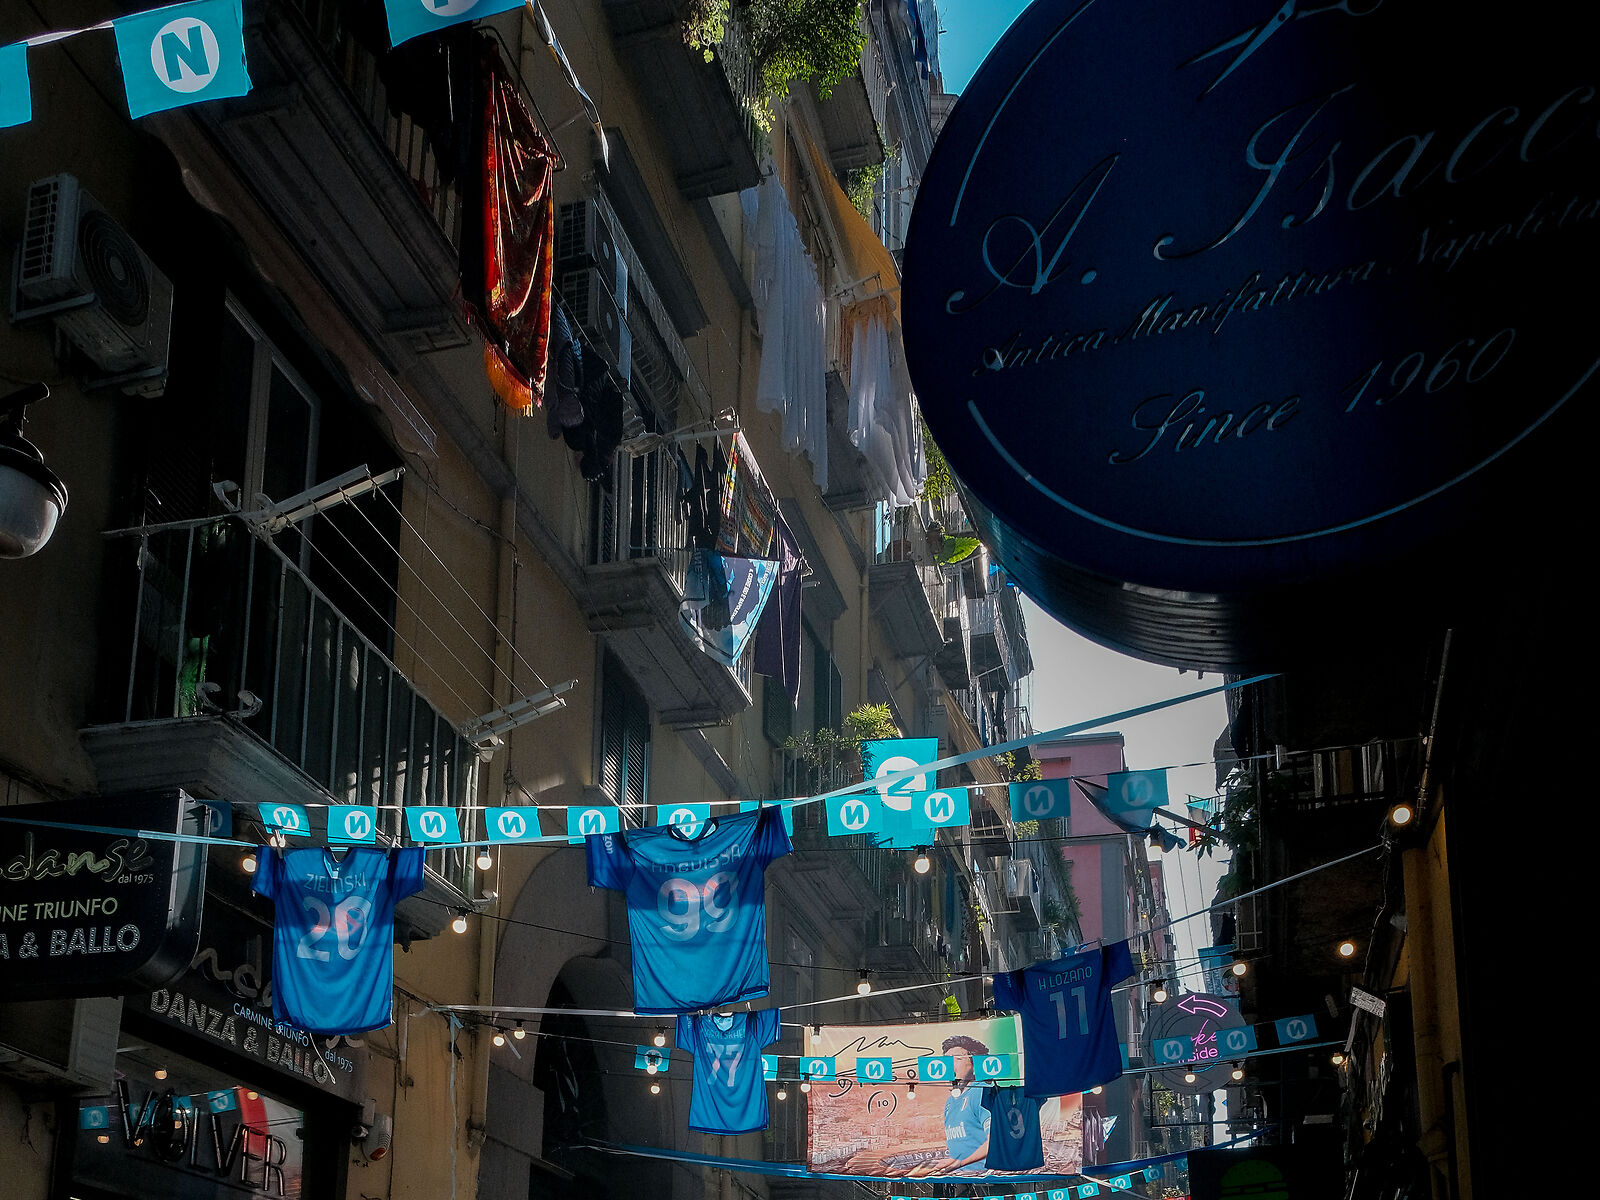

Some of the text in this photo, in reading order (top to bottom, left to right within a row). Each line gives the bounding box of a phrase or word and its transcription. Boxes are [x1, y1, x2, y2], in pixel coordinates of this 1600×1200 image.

[160, 25, 210, 81] N
[946, 82, 1600, 315] A. Isacc
[971, 327, 1106, 378] Antica
[1113, 262, 1378, 347] Manifattura
[1108, 327, 1518, 465] Since 1960
[118, 874, 154, 885] dal 1975
[657, 870, 740, 942] 99
[34, 896, 119, 921] TRIUNFO
[297, 895, 372, 962] 20
[18, 931, 40, 959] &
[49, 923, 141, 957] BALLO
[149, 988, 328, 1084] DANZA & BALLO
[233, 1002, 273, 1031] CARMINE
[1049, 986, 1089, 1040] 11
[324, 1049, 353, 1073] dal 1975
[706, 1042, 746, 1088] 77
[116, 1078, 288, 1196] VOLVER
[1007, 1108, 1026, 1140] 9
